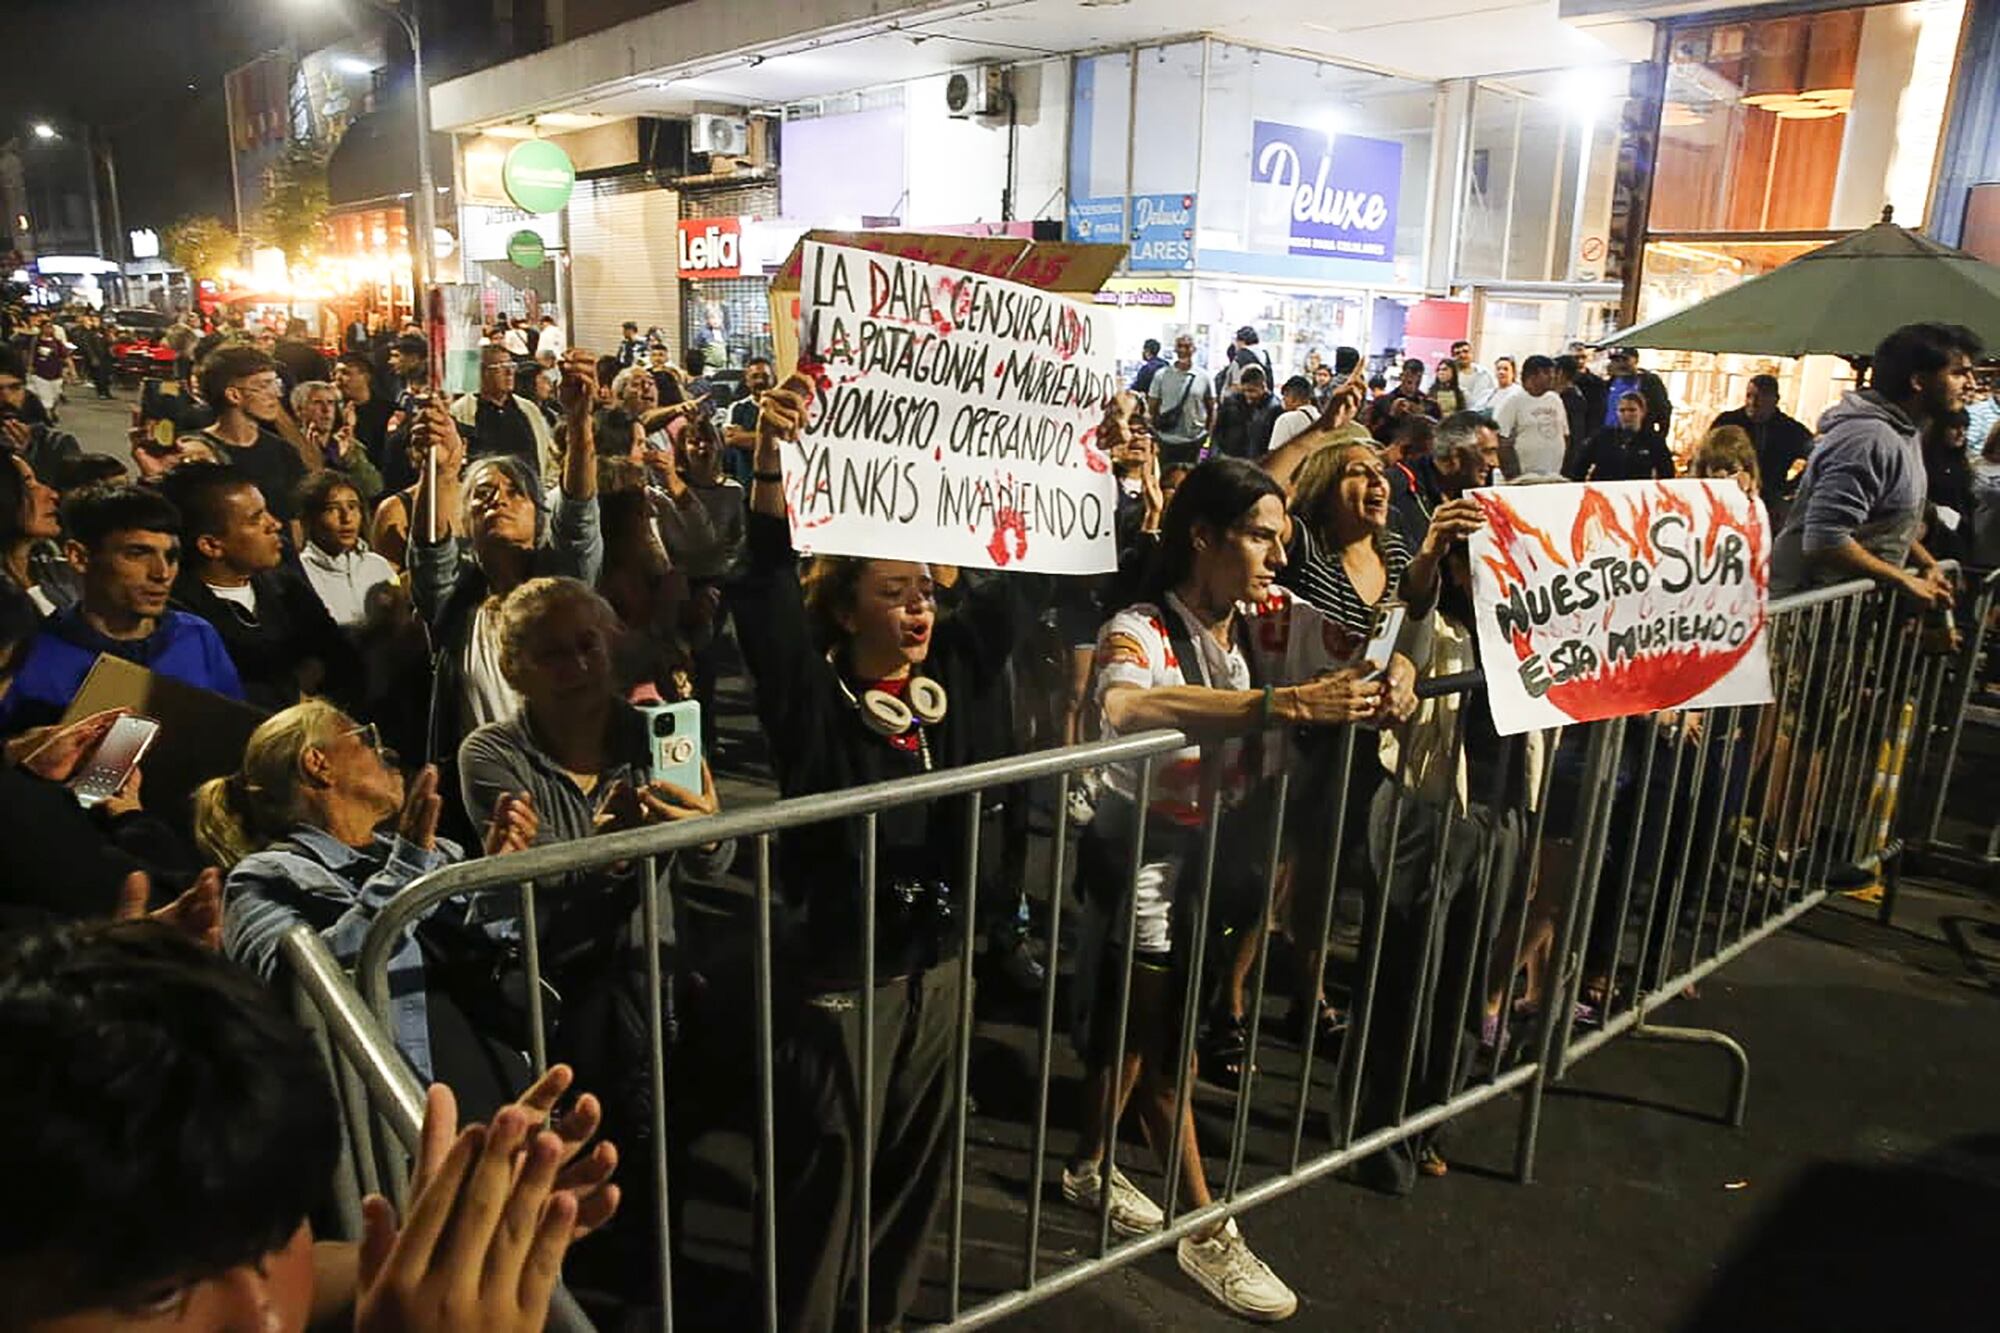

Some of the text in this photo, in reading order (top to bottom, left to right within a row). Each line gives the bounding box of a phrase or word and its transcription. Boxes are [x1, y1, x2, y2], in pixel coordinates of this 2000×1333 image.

[1258, 141, 1388, 232] Deluxe
[679, 226, 738, 269] Lelia
[1131, 241, 1189, 260] LARES
[808, 308, 855, 366] LA
[812, 246, 855, 313] LA
[951, 275, 1096, 356] CENSURANDO.
[950, 404, 1079, 468] OPERANDO.
[797, 440, 919, 524] YANKIS
[1496, 516, 1744, 643] NUESTRO SUR
[1517, 610, 1746, 698] ESTÁ MURIENDO
